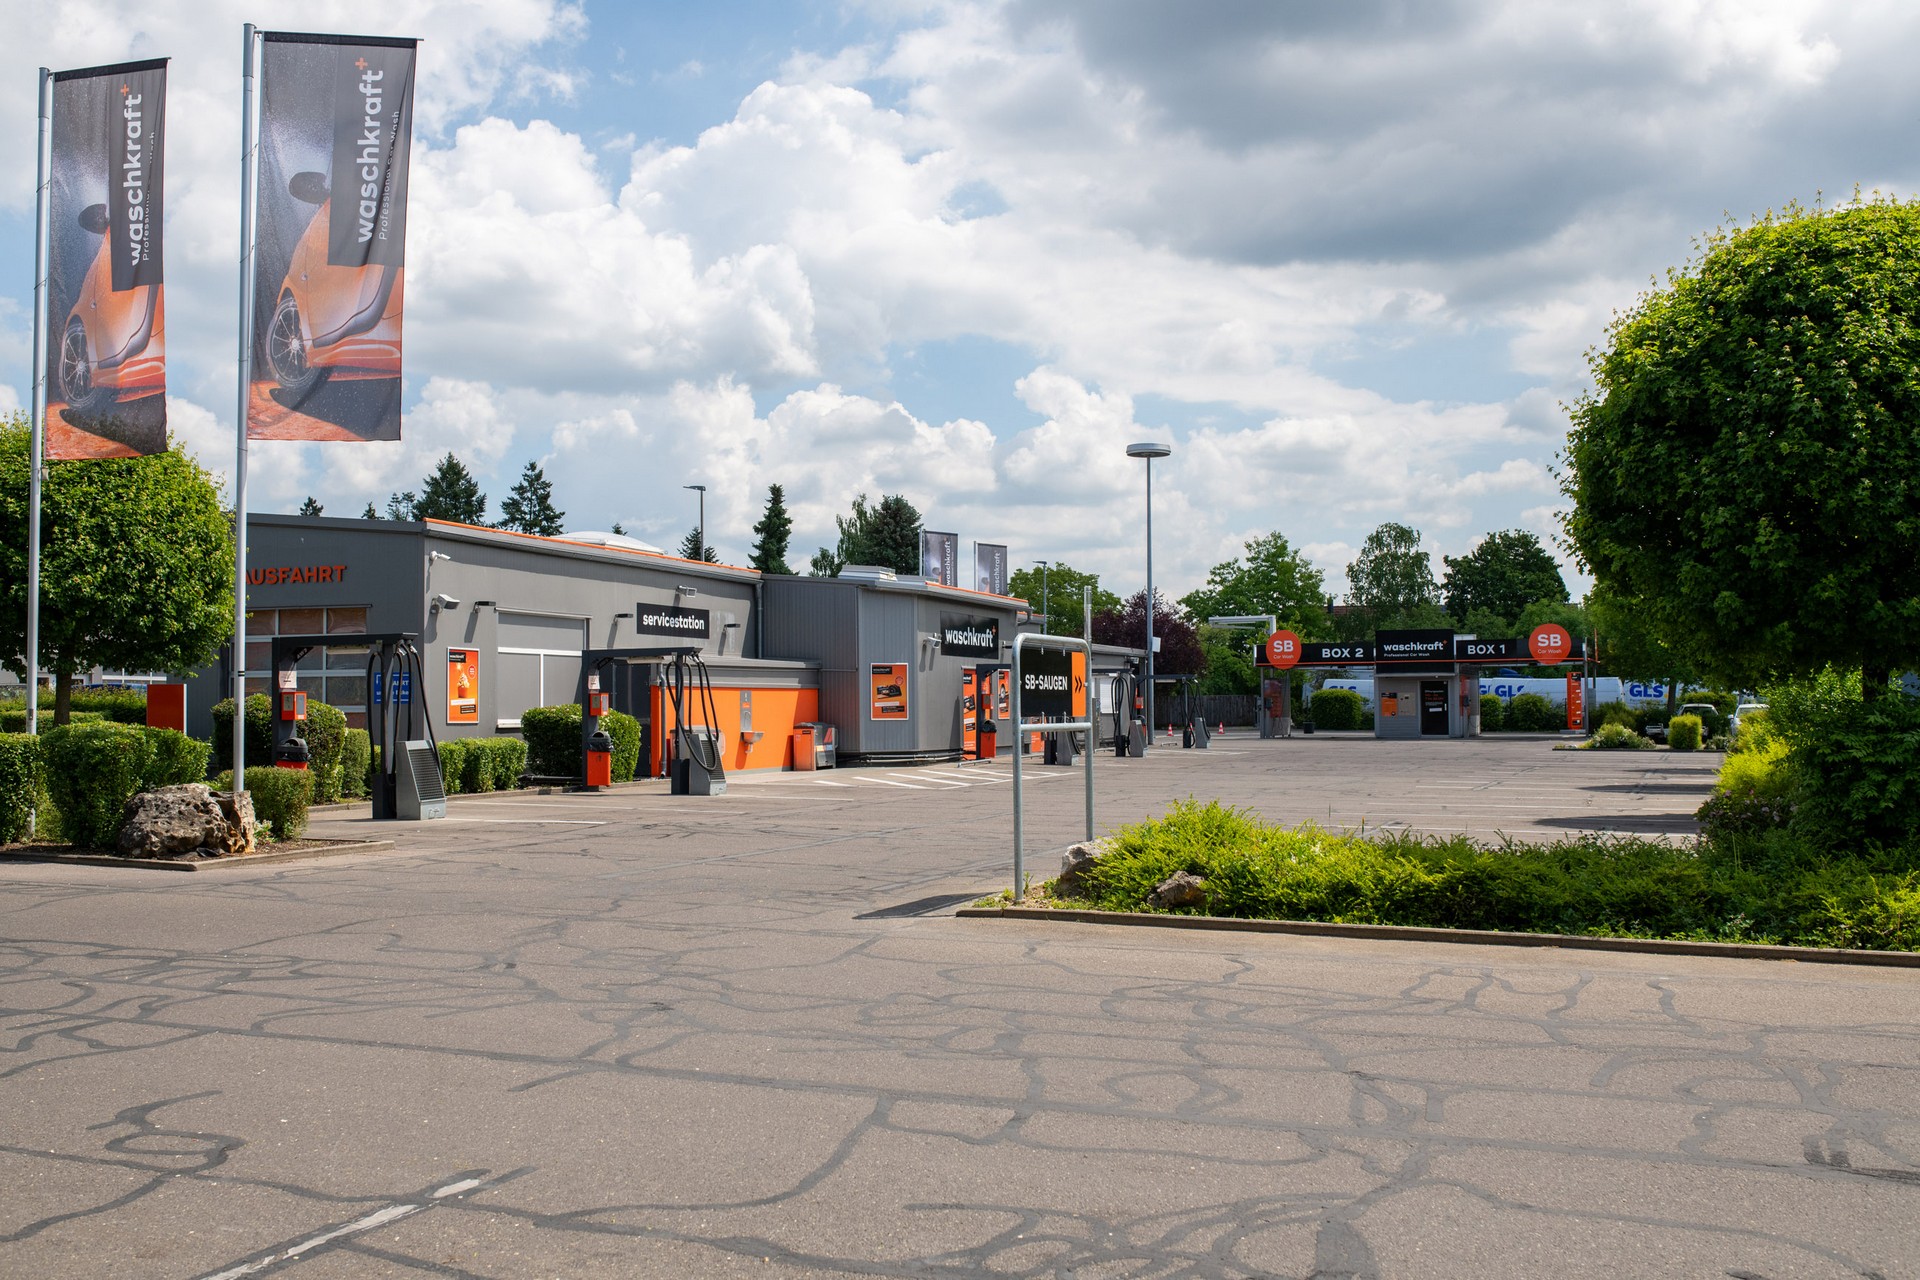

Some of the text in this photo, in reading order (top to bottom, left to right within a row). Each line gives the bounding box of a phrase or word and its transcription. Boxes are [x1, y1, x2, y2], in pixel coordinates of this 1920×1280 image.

[356, 70, 383, 243] waschkraft
[123, 93, 143, 266] waschkraft
[642, 612, 705, 630] servicestation
[945, 626, 993, 648] waschkraft
[1537, 634, 1562, 647] SB
[1273, 640, 1294, 652] SB
[1322, 648, 1364, 658] BOX 2
[1383, 641, 1443, 651] waschkraft
[1467, 644, 1505, 654] BOX 1
[1025, 674, 1068, 691] SB-SAUGEN
[1629, 684, 1664, 698] GLS
